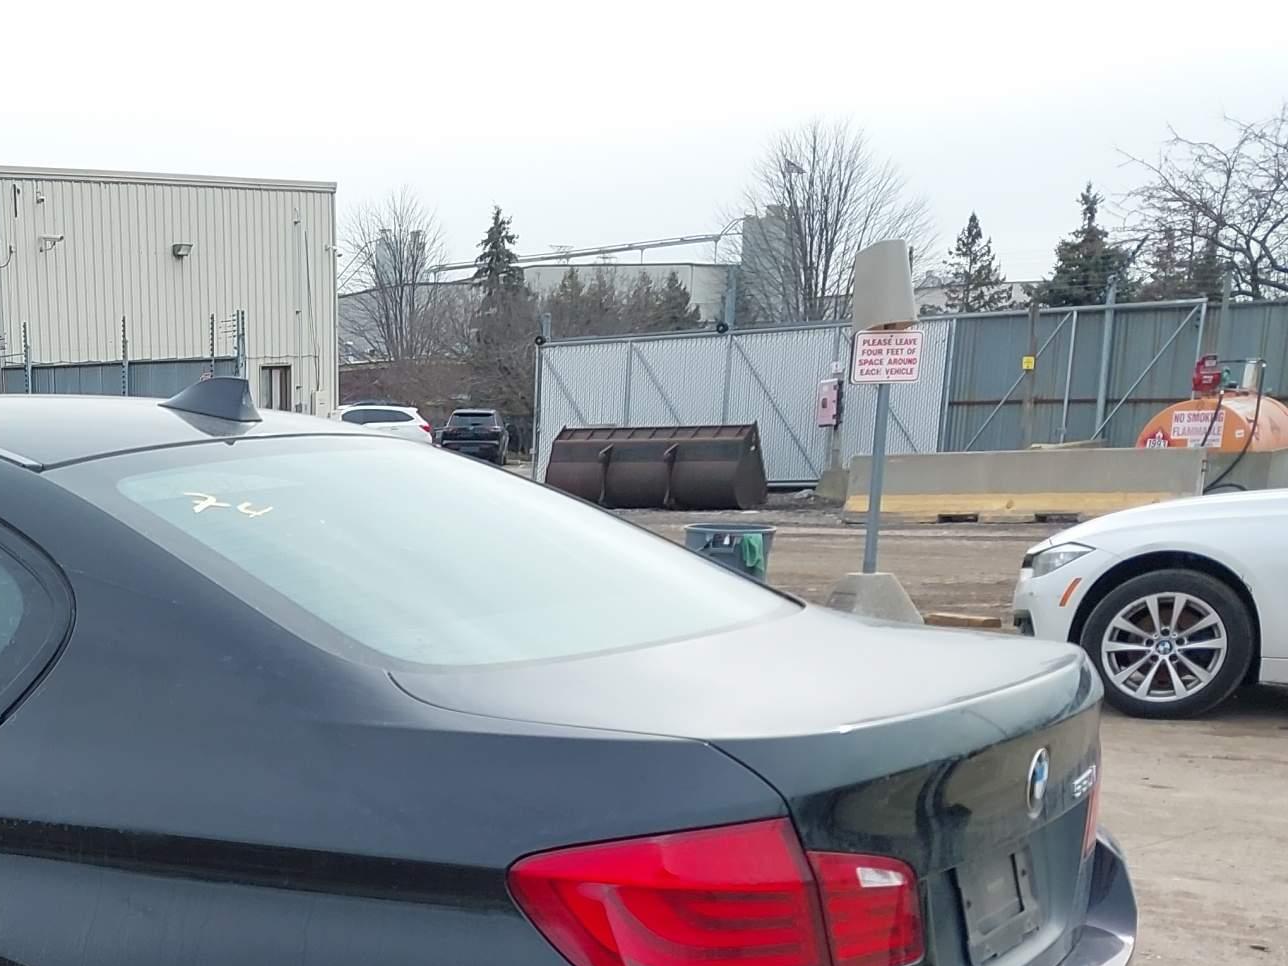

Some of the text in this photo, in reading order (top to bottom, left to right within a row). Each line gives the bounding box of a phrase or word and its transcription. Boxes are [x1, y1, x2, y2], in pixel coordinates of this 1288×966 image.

[862, 337, 918, 347] PLEASE LEAVE
[861, 348, 883, 356] FOUR
[906, 347, 916, 355] OF
[858, 357, 918, 366] SPACE AROUND
[859, 367, 914, 376] EACH VEHICLE
[1174, 412, 1185, 423] NO
